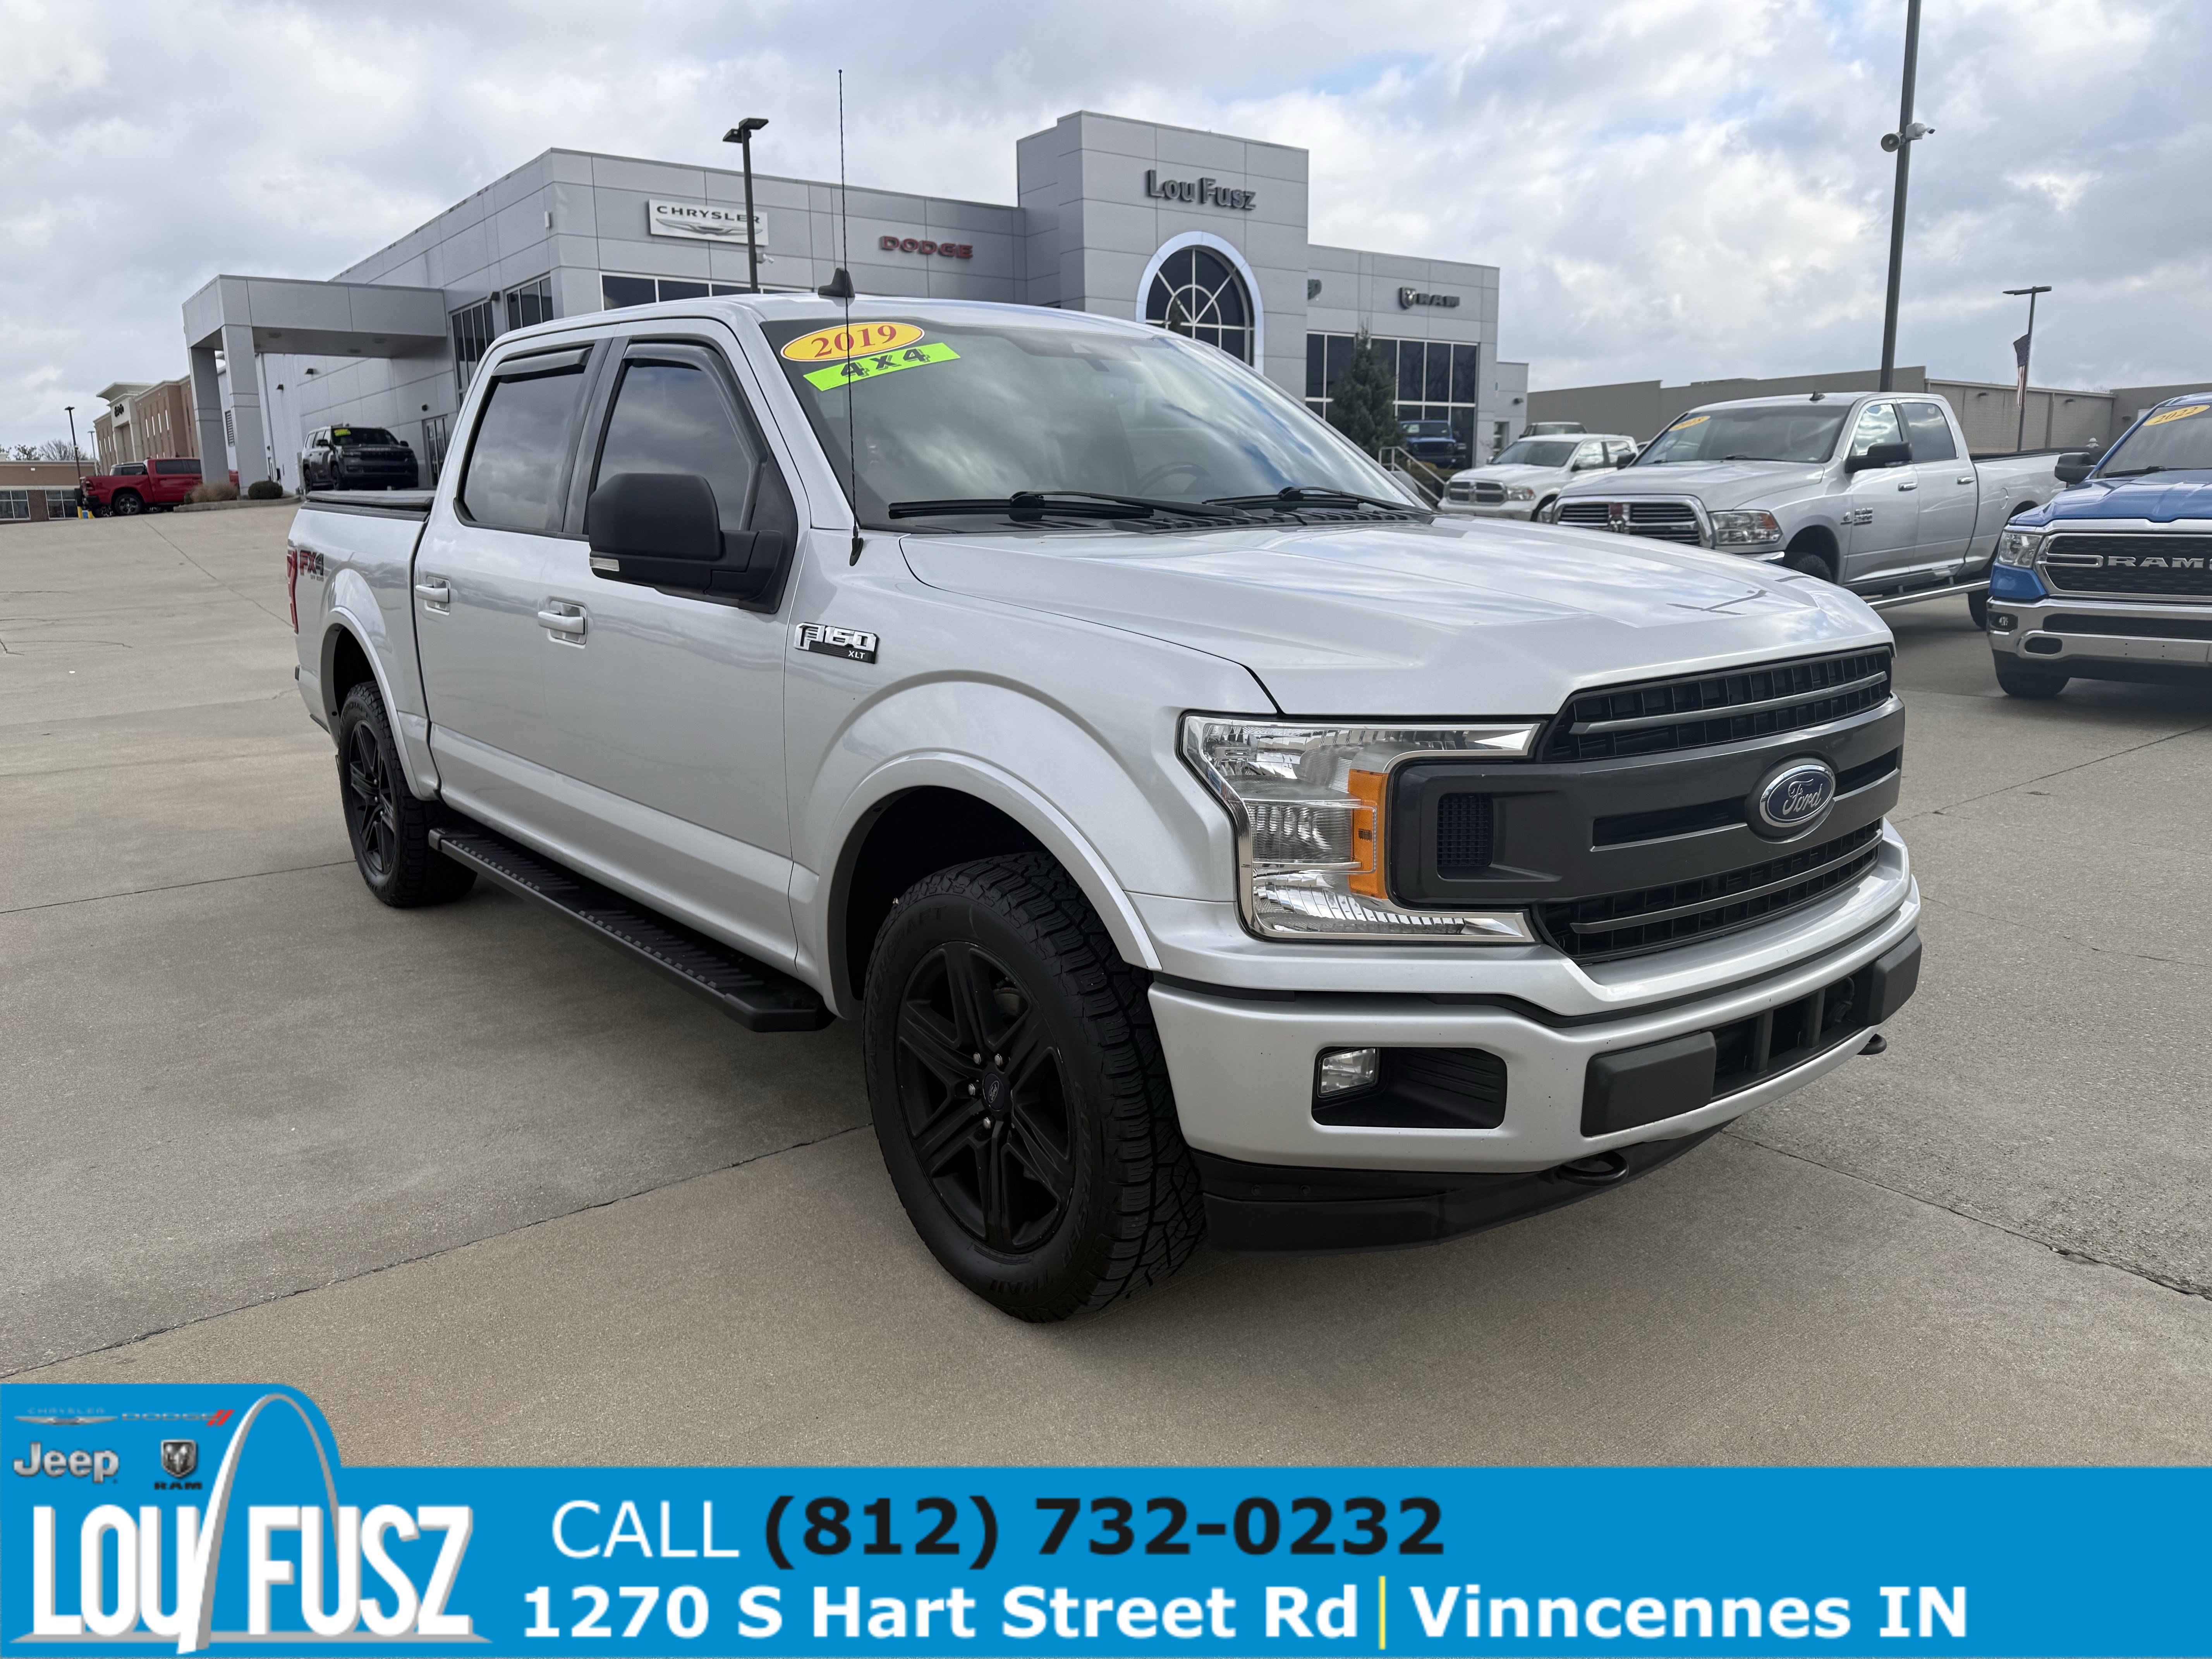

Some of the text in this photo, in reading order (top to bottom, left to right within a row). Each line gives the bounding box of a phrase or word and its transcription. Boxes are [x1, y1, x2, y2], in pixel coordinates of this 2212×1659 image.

[1145, 169, 1256, 210] Lou Fusz
[656, 206, 760, 224] CHRYSLER
[879, 235, 973, 258] DODGE
[811, 325, 897, 358] 2019
[300, 550, 324, 576] FX4
[2107, 556, 2204, 568] RAM
[848, 650, 866, 659] XLT
[1782, 778, 1823, 815] Ford
